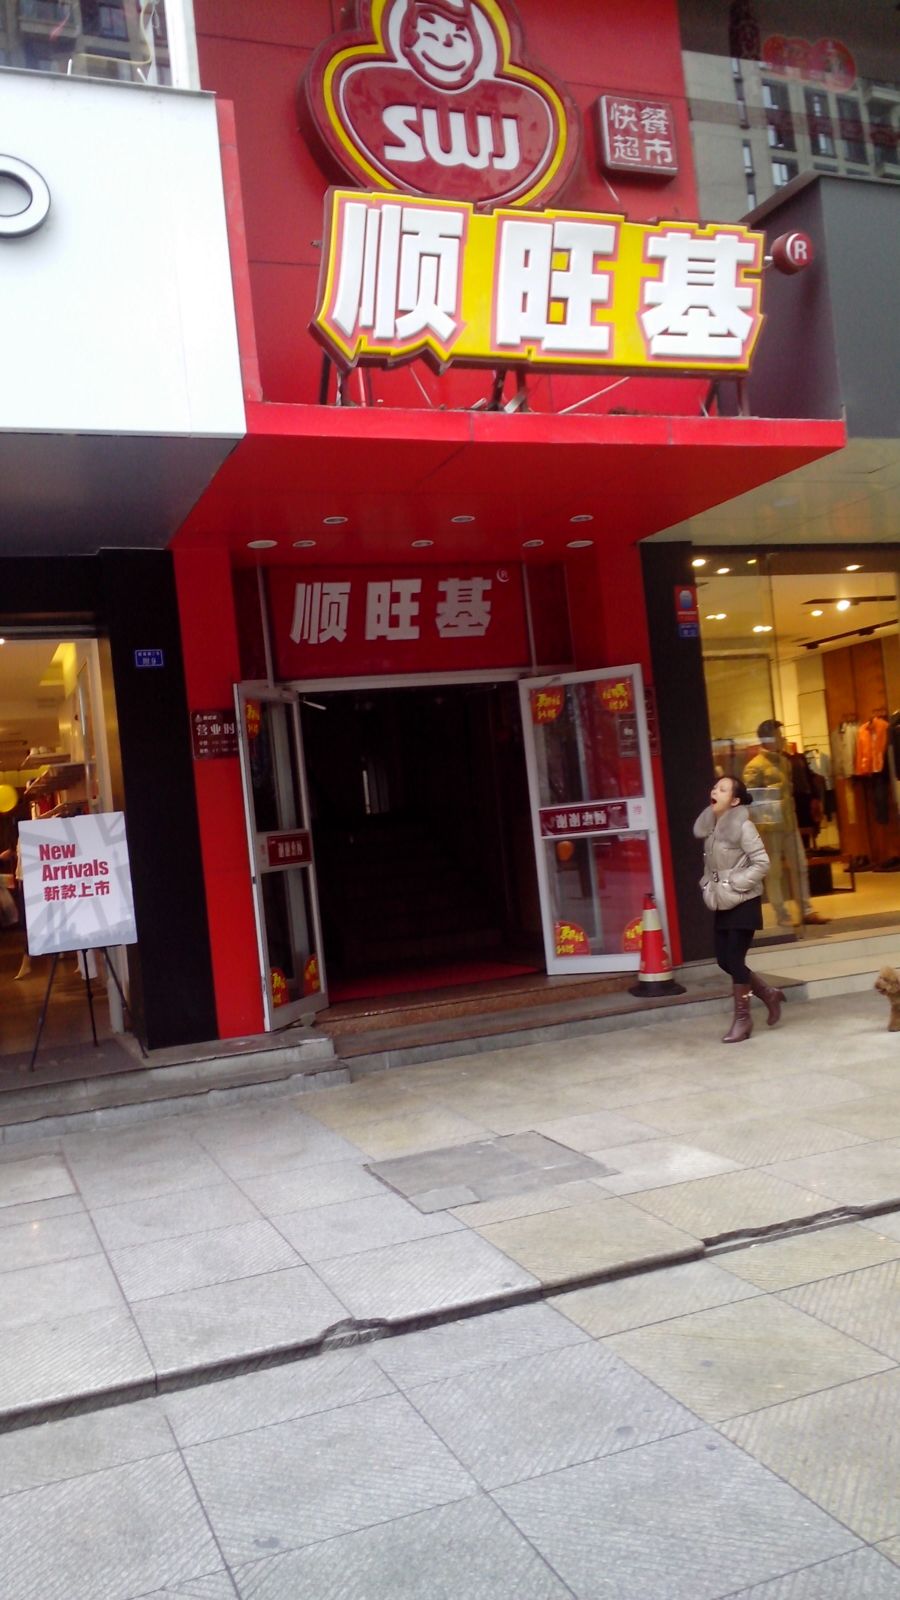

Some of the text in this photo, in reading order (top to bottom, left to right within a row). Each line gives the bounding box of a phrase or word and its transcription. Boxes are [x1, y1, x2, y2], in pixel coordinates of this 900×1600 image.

[610, 103, 669, 135] 快餐
[613, 134, 673, 165] 超市
[332, 201, 756, 358] 顺旺基
[289, 576, 493, 644] 顺旺基
[39, 843, 76, 861] New
[42, 859, 109, 882] Arrivals
[44, 880, 110, 902] 新款上市
